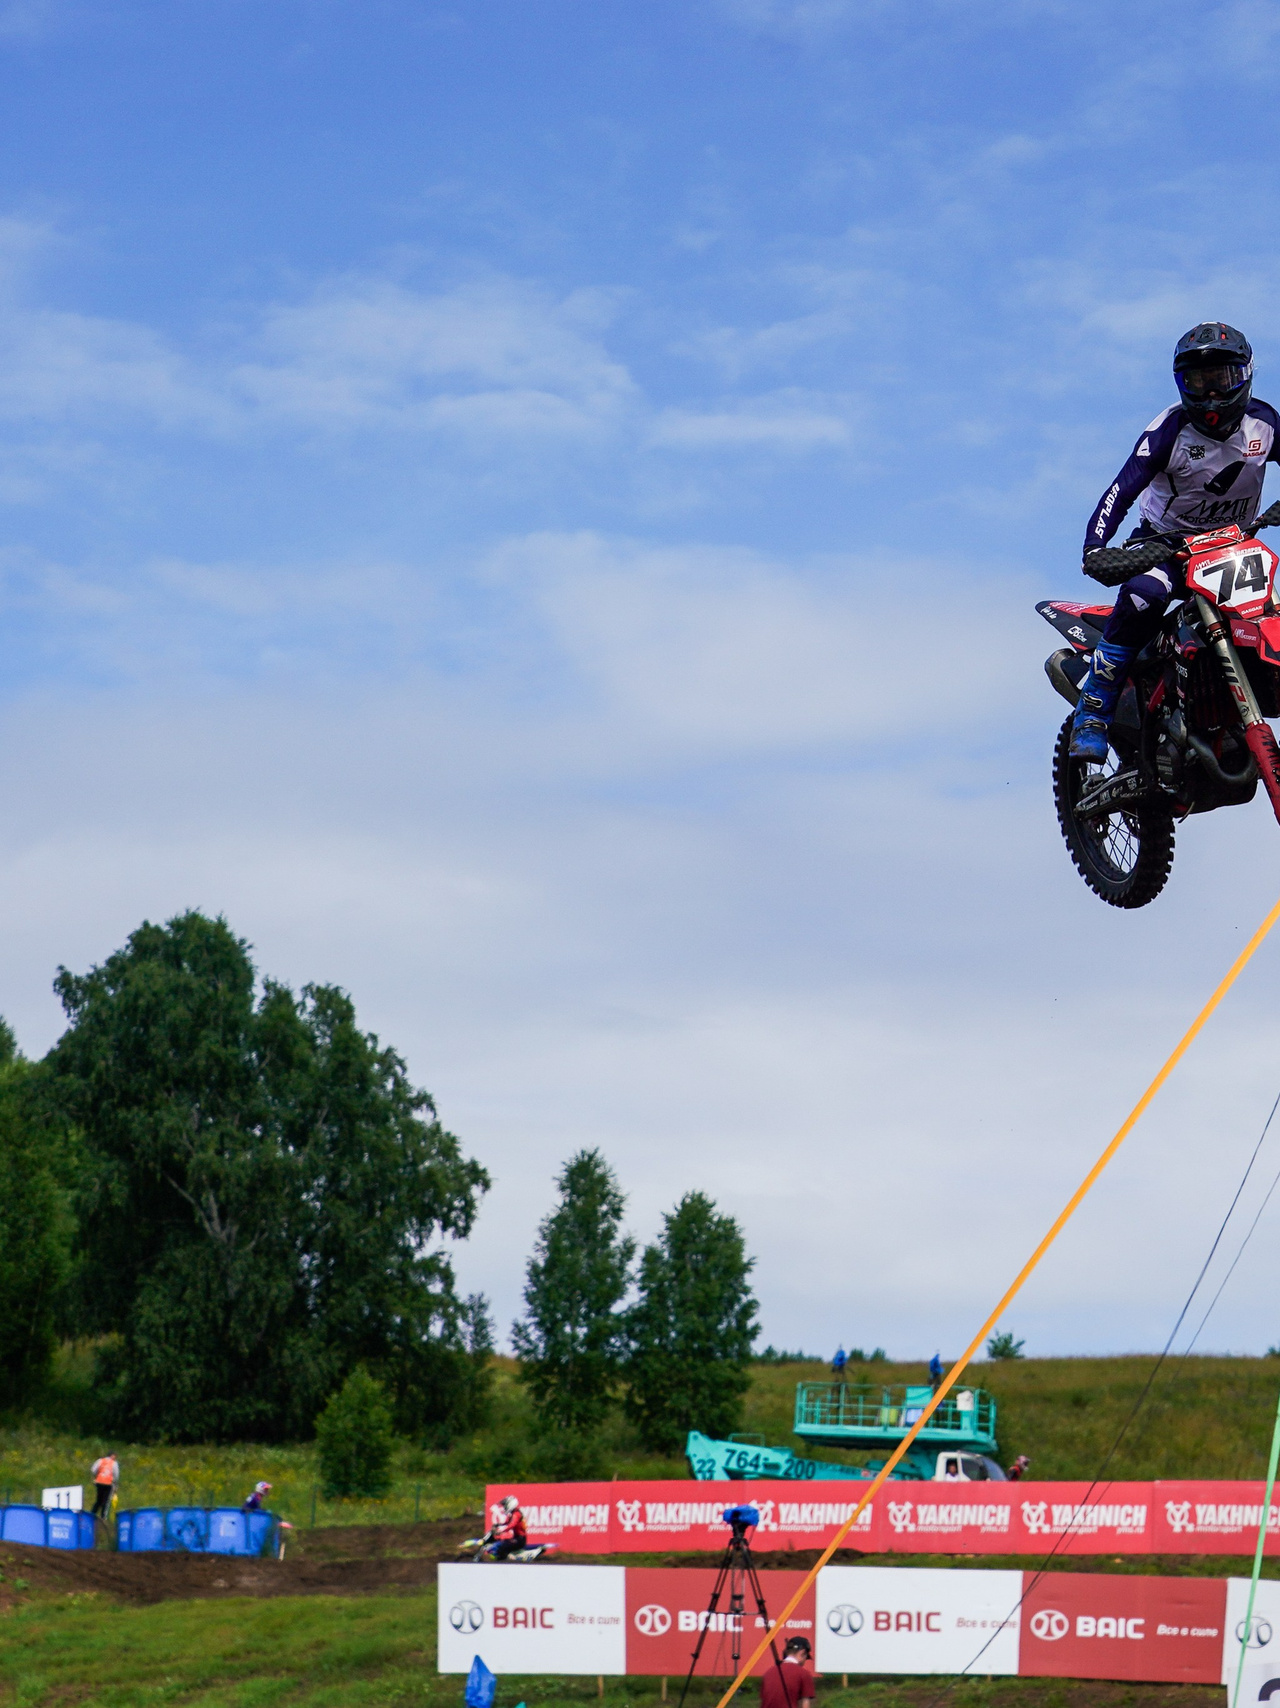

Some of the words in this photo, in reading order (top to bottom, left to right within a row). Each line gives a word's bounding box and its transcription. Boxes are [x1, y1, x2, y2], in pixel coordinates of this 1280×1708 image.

[1202, 553, 1268, 605] 74
[916, 1504, 1011, 1526] YAKHNICH
[1051, 1504, 1147, 1527] YAKHNICH
[493, 1607, 554, 1629] BAIC
[678, 1610, 744, 1632] BAIC
[873, 1610, 941, 1632] BAIC
[1076, 1615, 1145, 1639] BAIC
